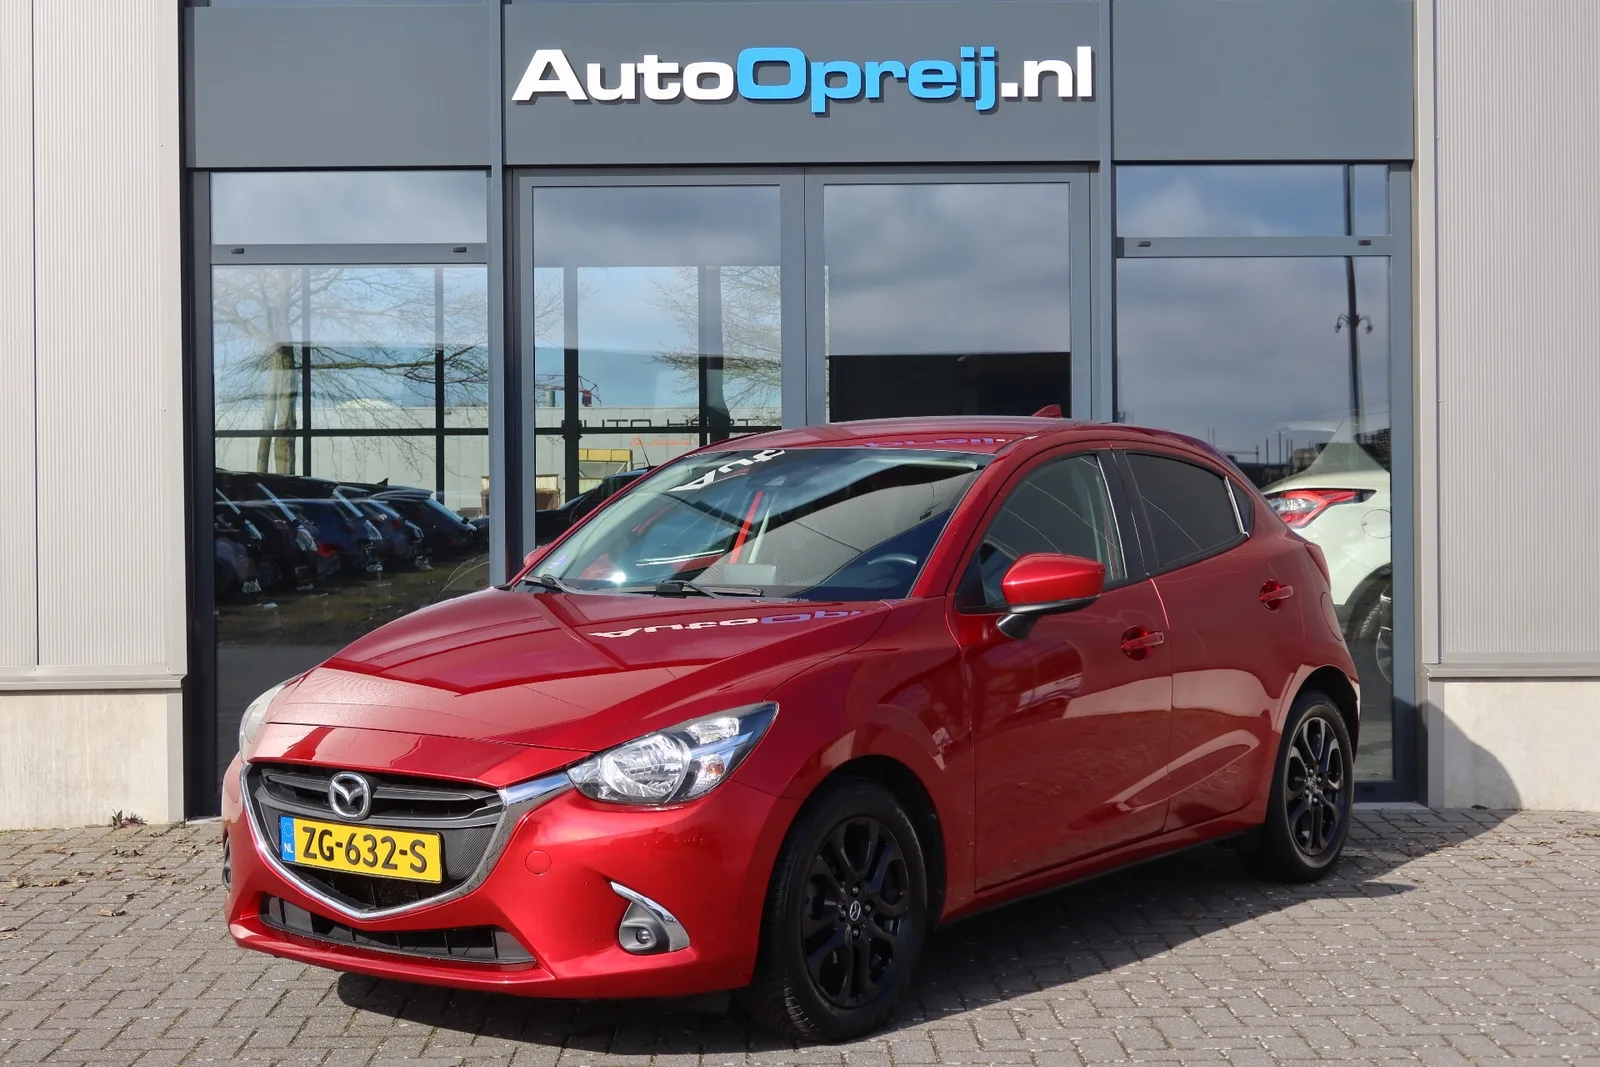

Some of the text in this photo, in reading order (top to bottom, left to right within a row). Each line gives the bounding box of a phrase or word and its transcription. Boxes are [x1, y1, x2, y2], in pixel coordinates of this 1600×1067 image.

[511, 46, 1092, 113] AutoOpreij.nl
[283, 842, 294, 854] NL
[302, 826, 428, 874] ZG-632-S
